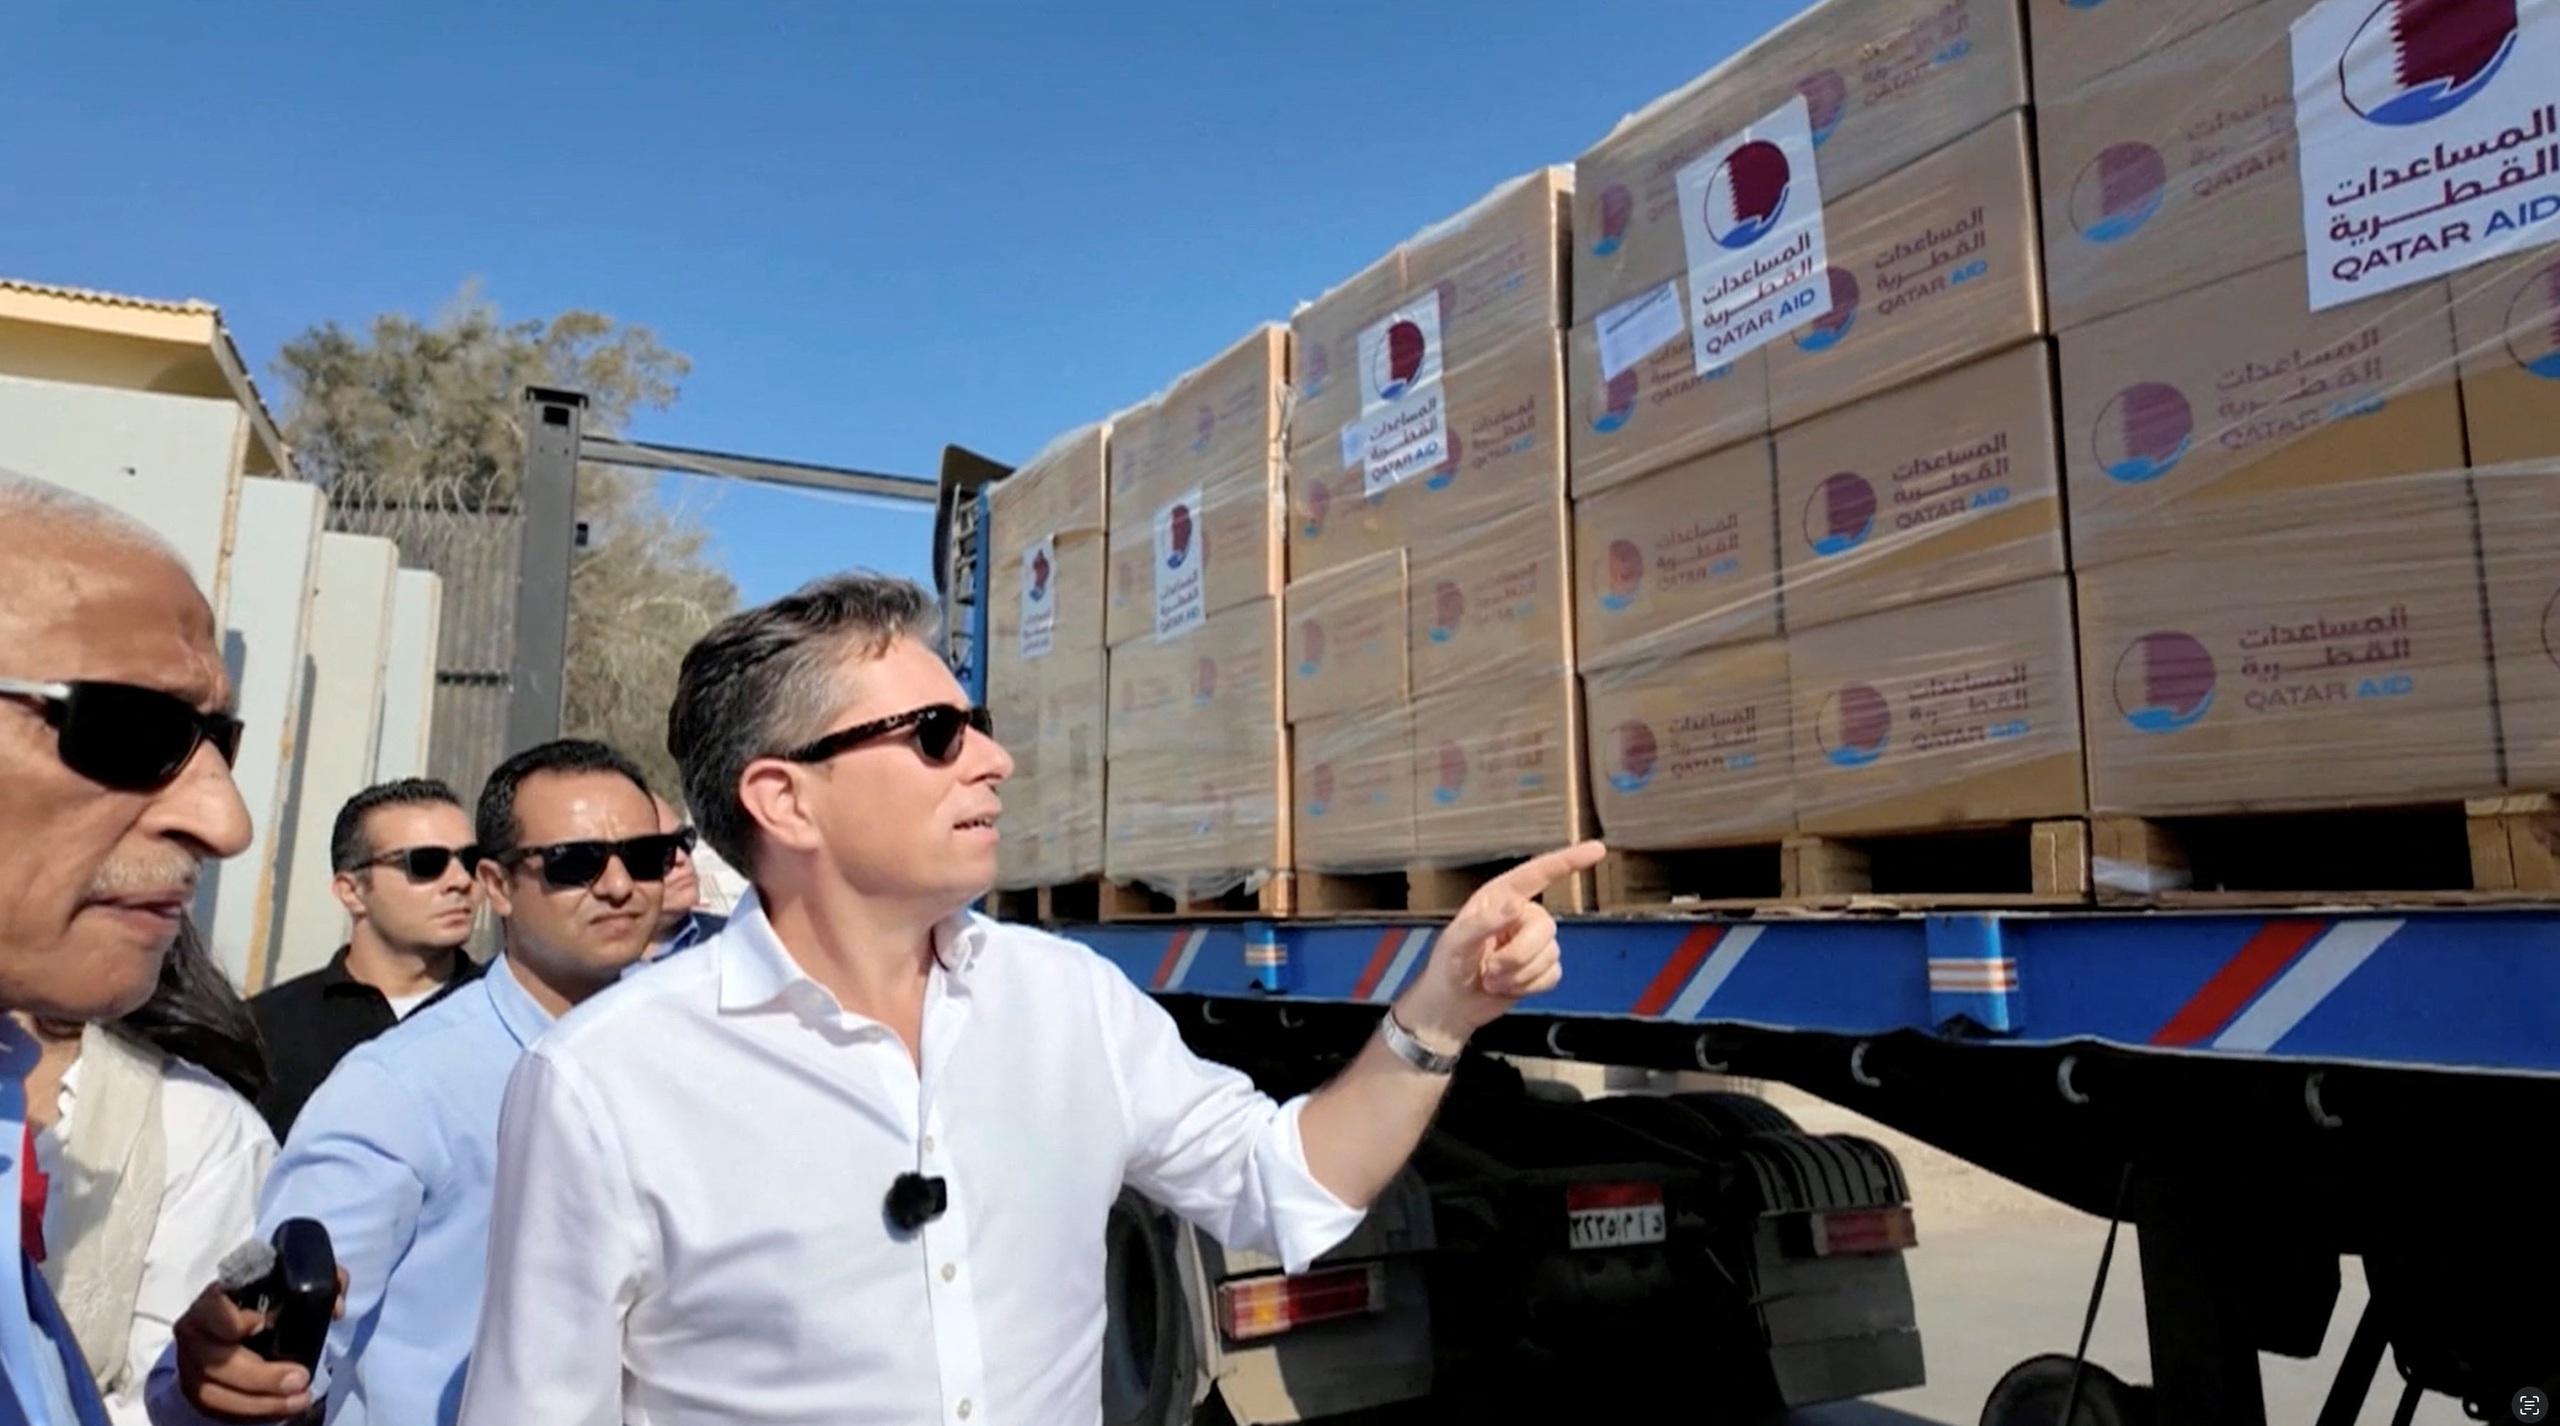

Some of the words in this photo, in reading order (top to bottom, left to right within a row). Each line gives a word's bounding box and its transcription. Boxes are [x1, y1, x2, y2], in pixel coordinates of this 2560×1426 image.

[2327, 104, 2556, 207] المساعدات
[2330, 143, 2559, 247] القطرية
[1875, 206, 1984, 269] المساعدات
[2332, 221, 2471, 281] QATAR
[2483, 194, 2560, 238] AID
[1703, 231, 1811, 304] المساعدات
[1704, 256, 1813, 332] القطرية
[1878, 275, 1945, 315] QATAR
[1950, 259, 1988, 285] AID
[1706, 309, 1773, 354] QATAR
[1779, 287, 1815, 319] AID
[2216, 328, 2379, 391] المساعدات
[1370, 396, 1437, 442] المساعدات
[1371, 453, 1413, 482] QATAR
[1415, 441, 1438, 461] AID
[1892, 432, 2007, 482] المساعدات
[1896, 497, 1966, 530] QATAR
[1970, 486, 2010, 511] AID
[2239, 605, 2408, 650] المساعدات
[1909, 664, 2027, 700] المساعدات
[2241, 636, 2411, 682] القطرية
[2245, 681, 2349, 712] QATAR
[2355, 674, 2413, 698] AID
